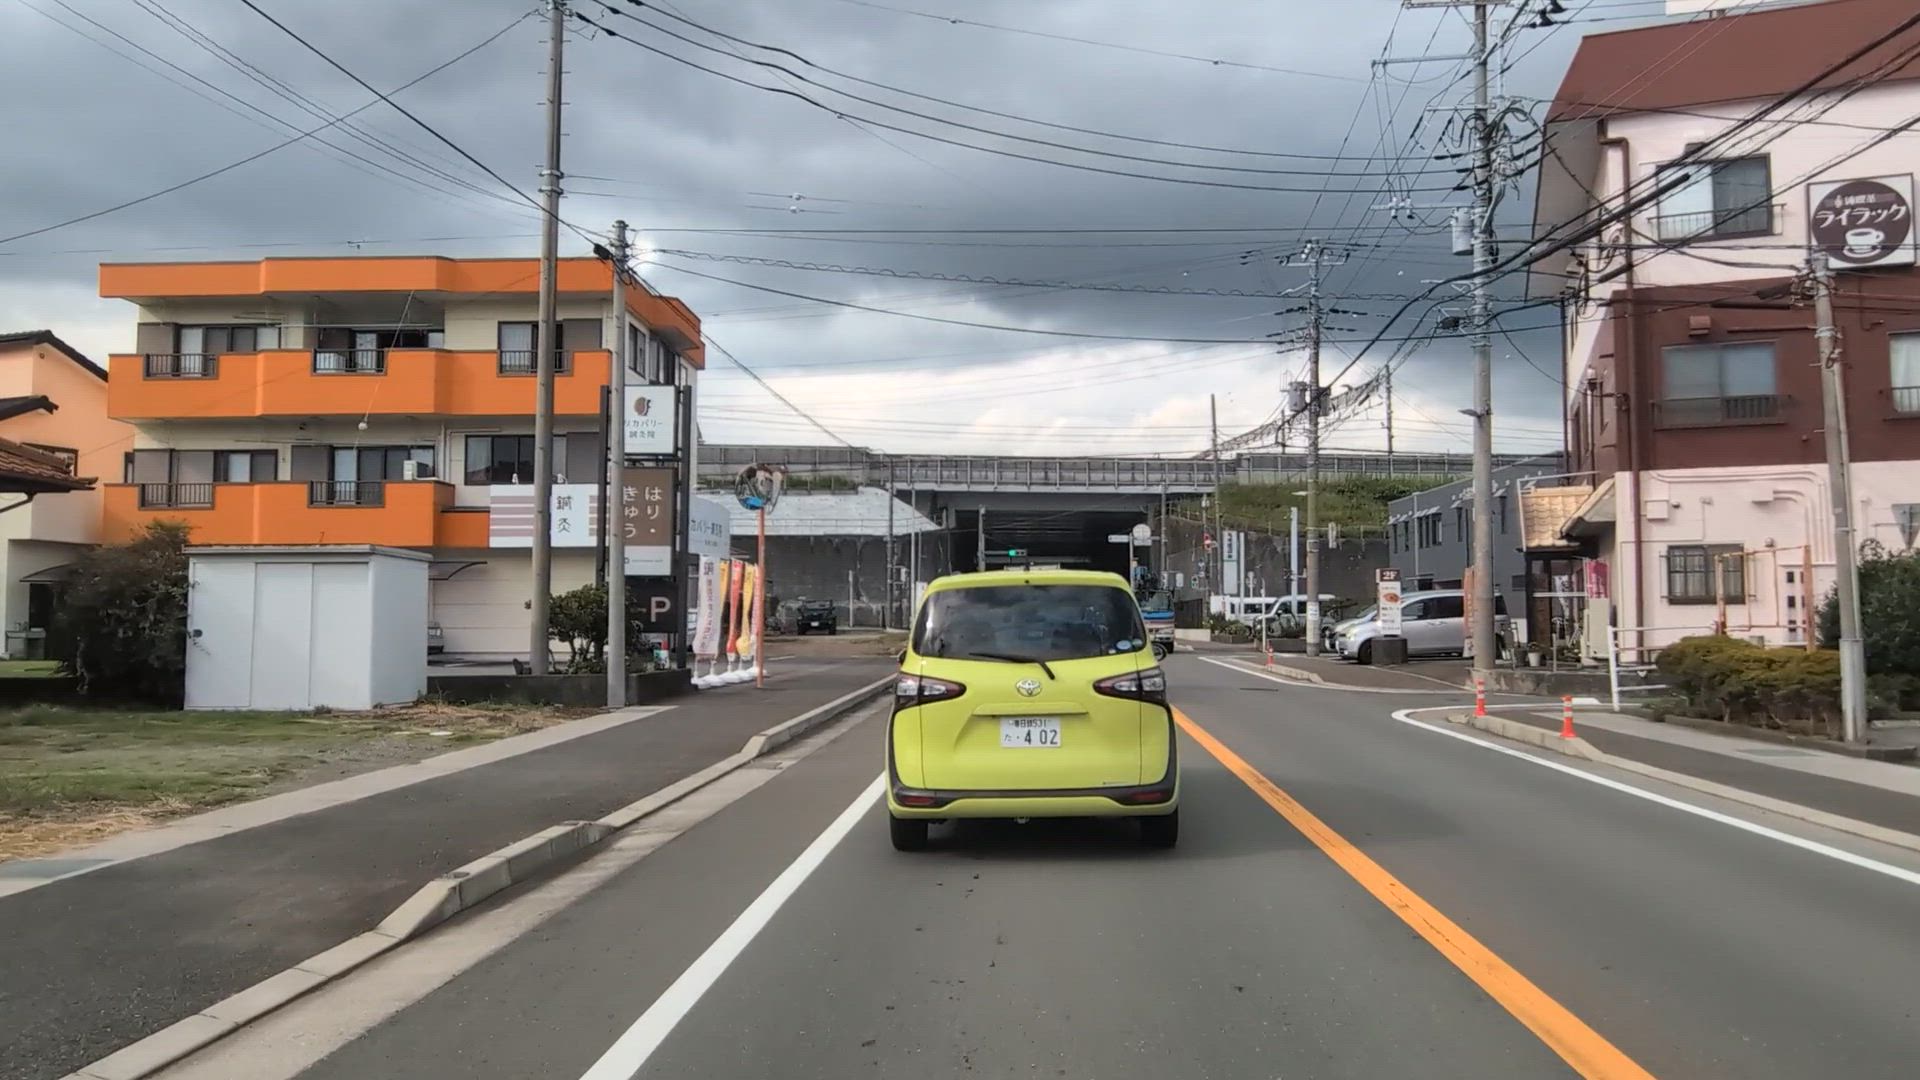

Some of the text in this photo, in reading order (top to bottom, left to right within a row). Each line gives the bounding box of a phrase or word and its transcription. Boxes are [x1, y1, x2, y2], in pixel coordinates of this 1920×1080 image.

[1815, 203, 1907, 229] ライラック
[556, 495, 573, 533] 鍼灸
[623, 486, 639, 538] きゅう
[1382, 570, 1398, 580] 2F
[650, 596, 671, 623] P
